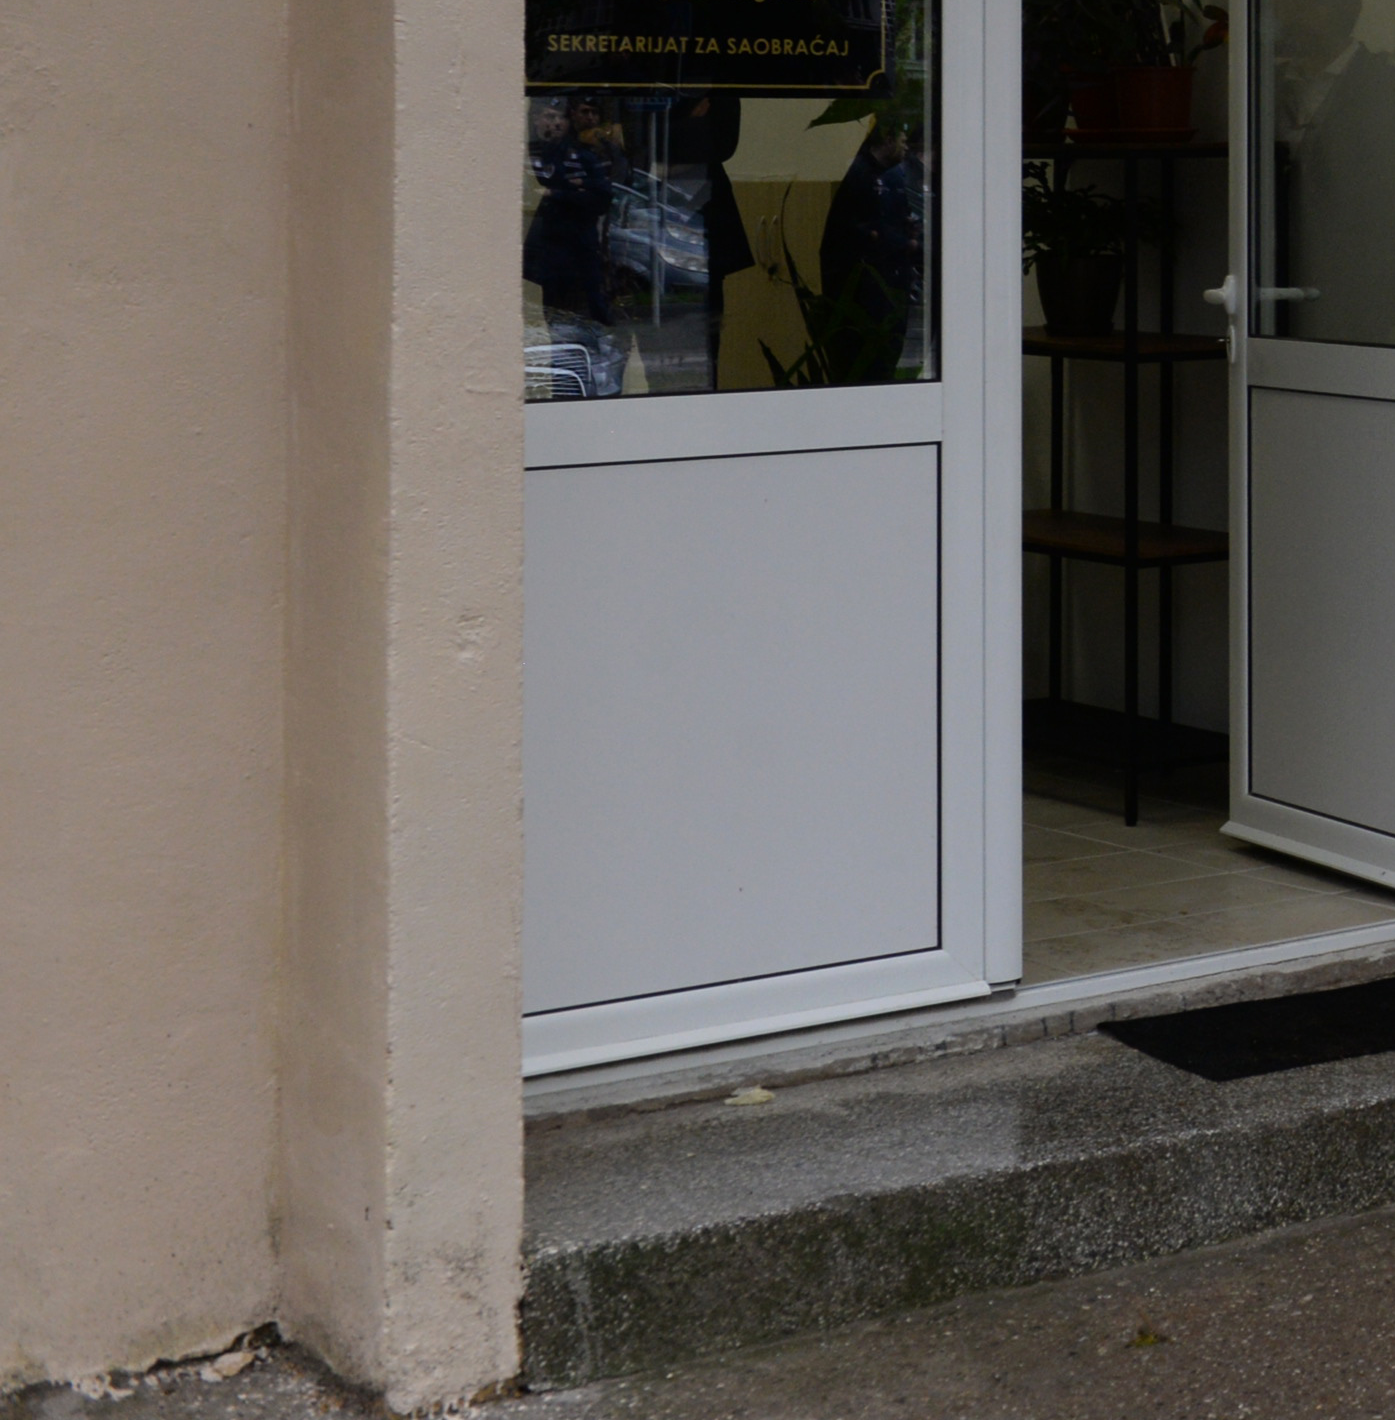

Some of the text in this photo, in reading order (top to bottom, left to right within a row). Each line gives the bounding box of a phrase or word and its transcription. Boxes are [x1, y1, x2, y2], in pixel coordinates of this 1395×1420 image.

[547, 34, 849, 57] SEKRETARIJAT ZA SAOBRAĆAJ
